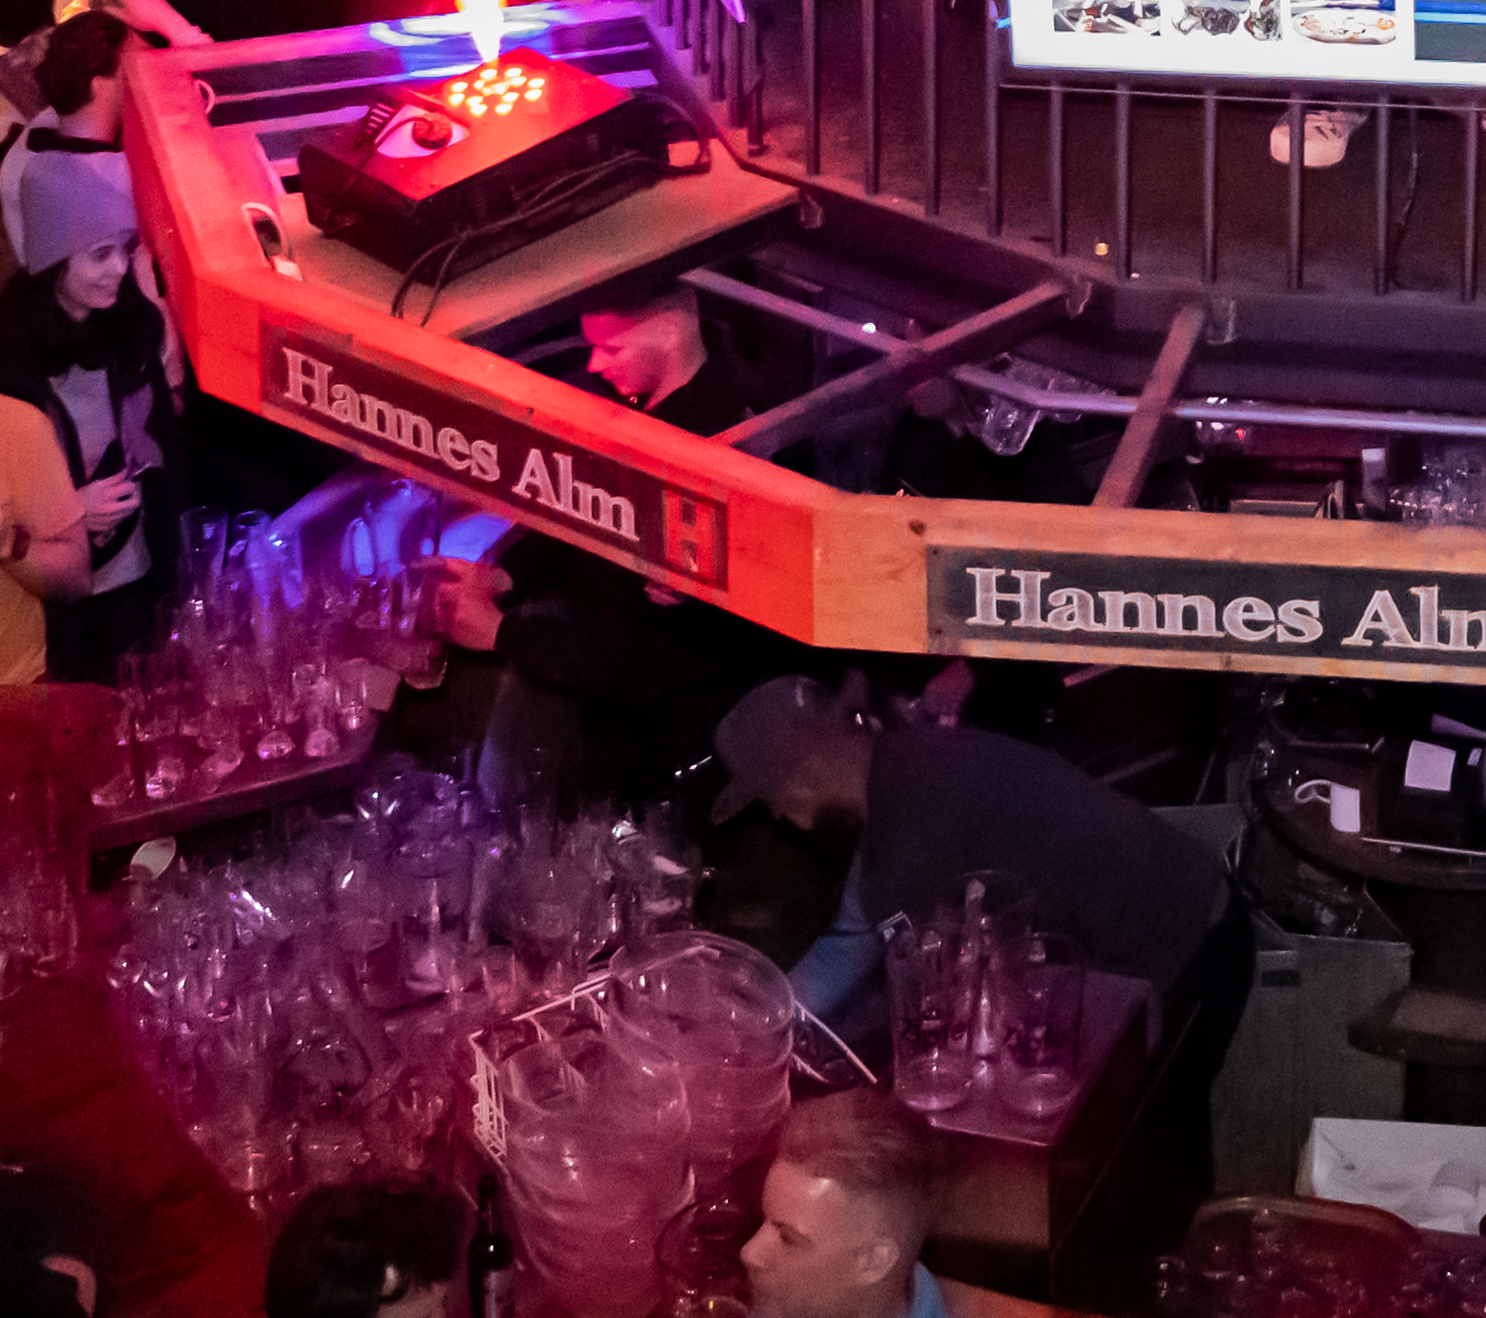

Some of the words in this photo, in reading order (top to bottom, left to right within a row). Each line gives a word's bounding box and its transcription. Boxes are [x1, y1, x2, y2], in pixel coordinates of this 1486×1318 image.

[280, 345, 500, 483] Hannes
[512, 449, 642, 543] Alm
[965, 565, 1322, 646] Hannes
